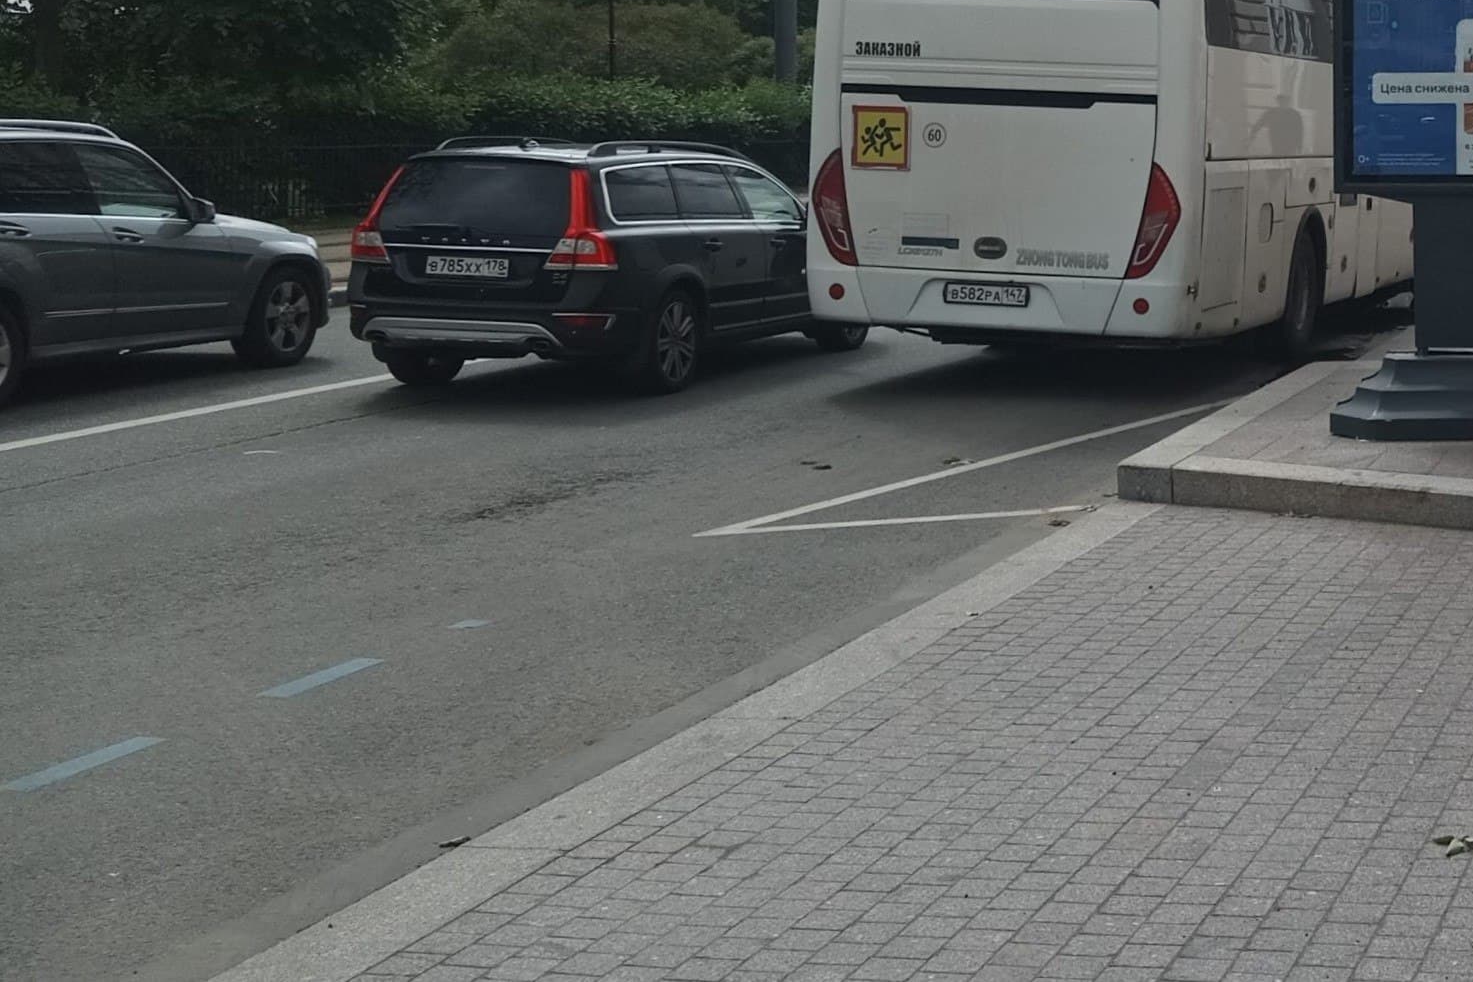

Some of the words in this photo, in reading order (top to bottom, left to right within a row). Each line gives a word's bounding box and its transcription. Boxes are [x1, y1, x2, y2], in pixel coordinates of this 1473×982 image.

[855, 40, 921, 57] ЗАКАЗНОЙ
[1380, 83, 1412, 95] Цена
[1414, 83, 1470, 94] снижена
[927, 128, 942, 142] 60
[1358, 155, 1370, 164] 0+
